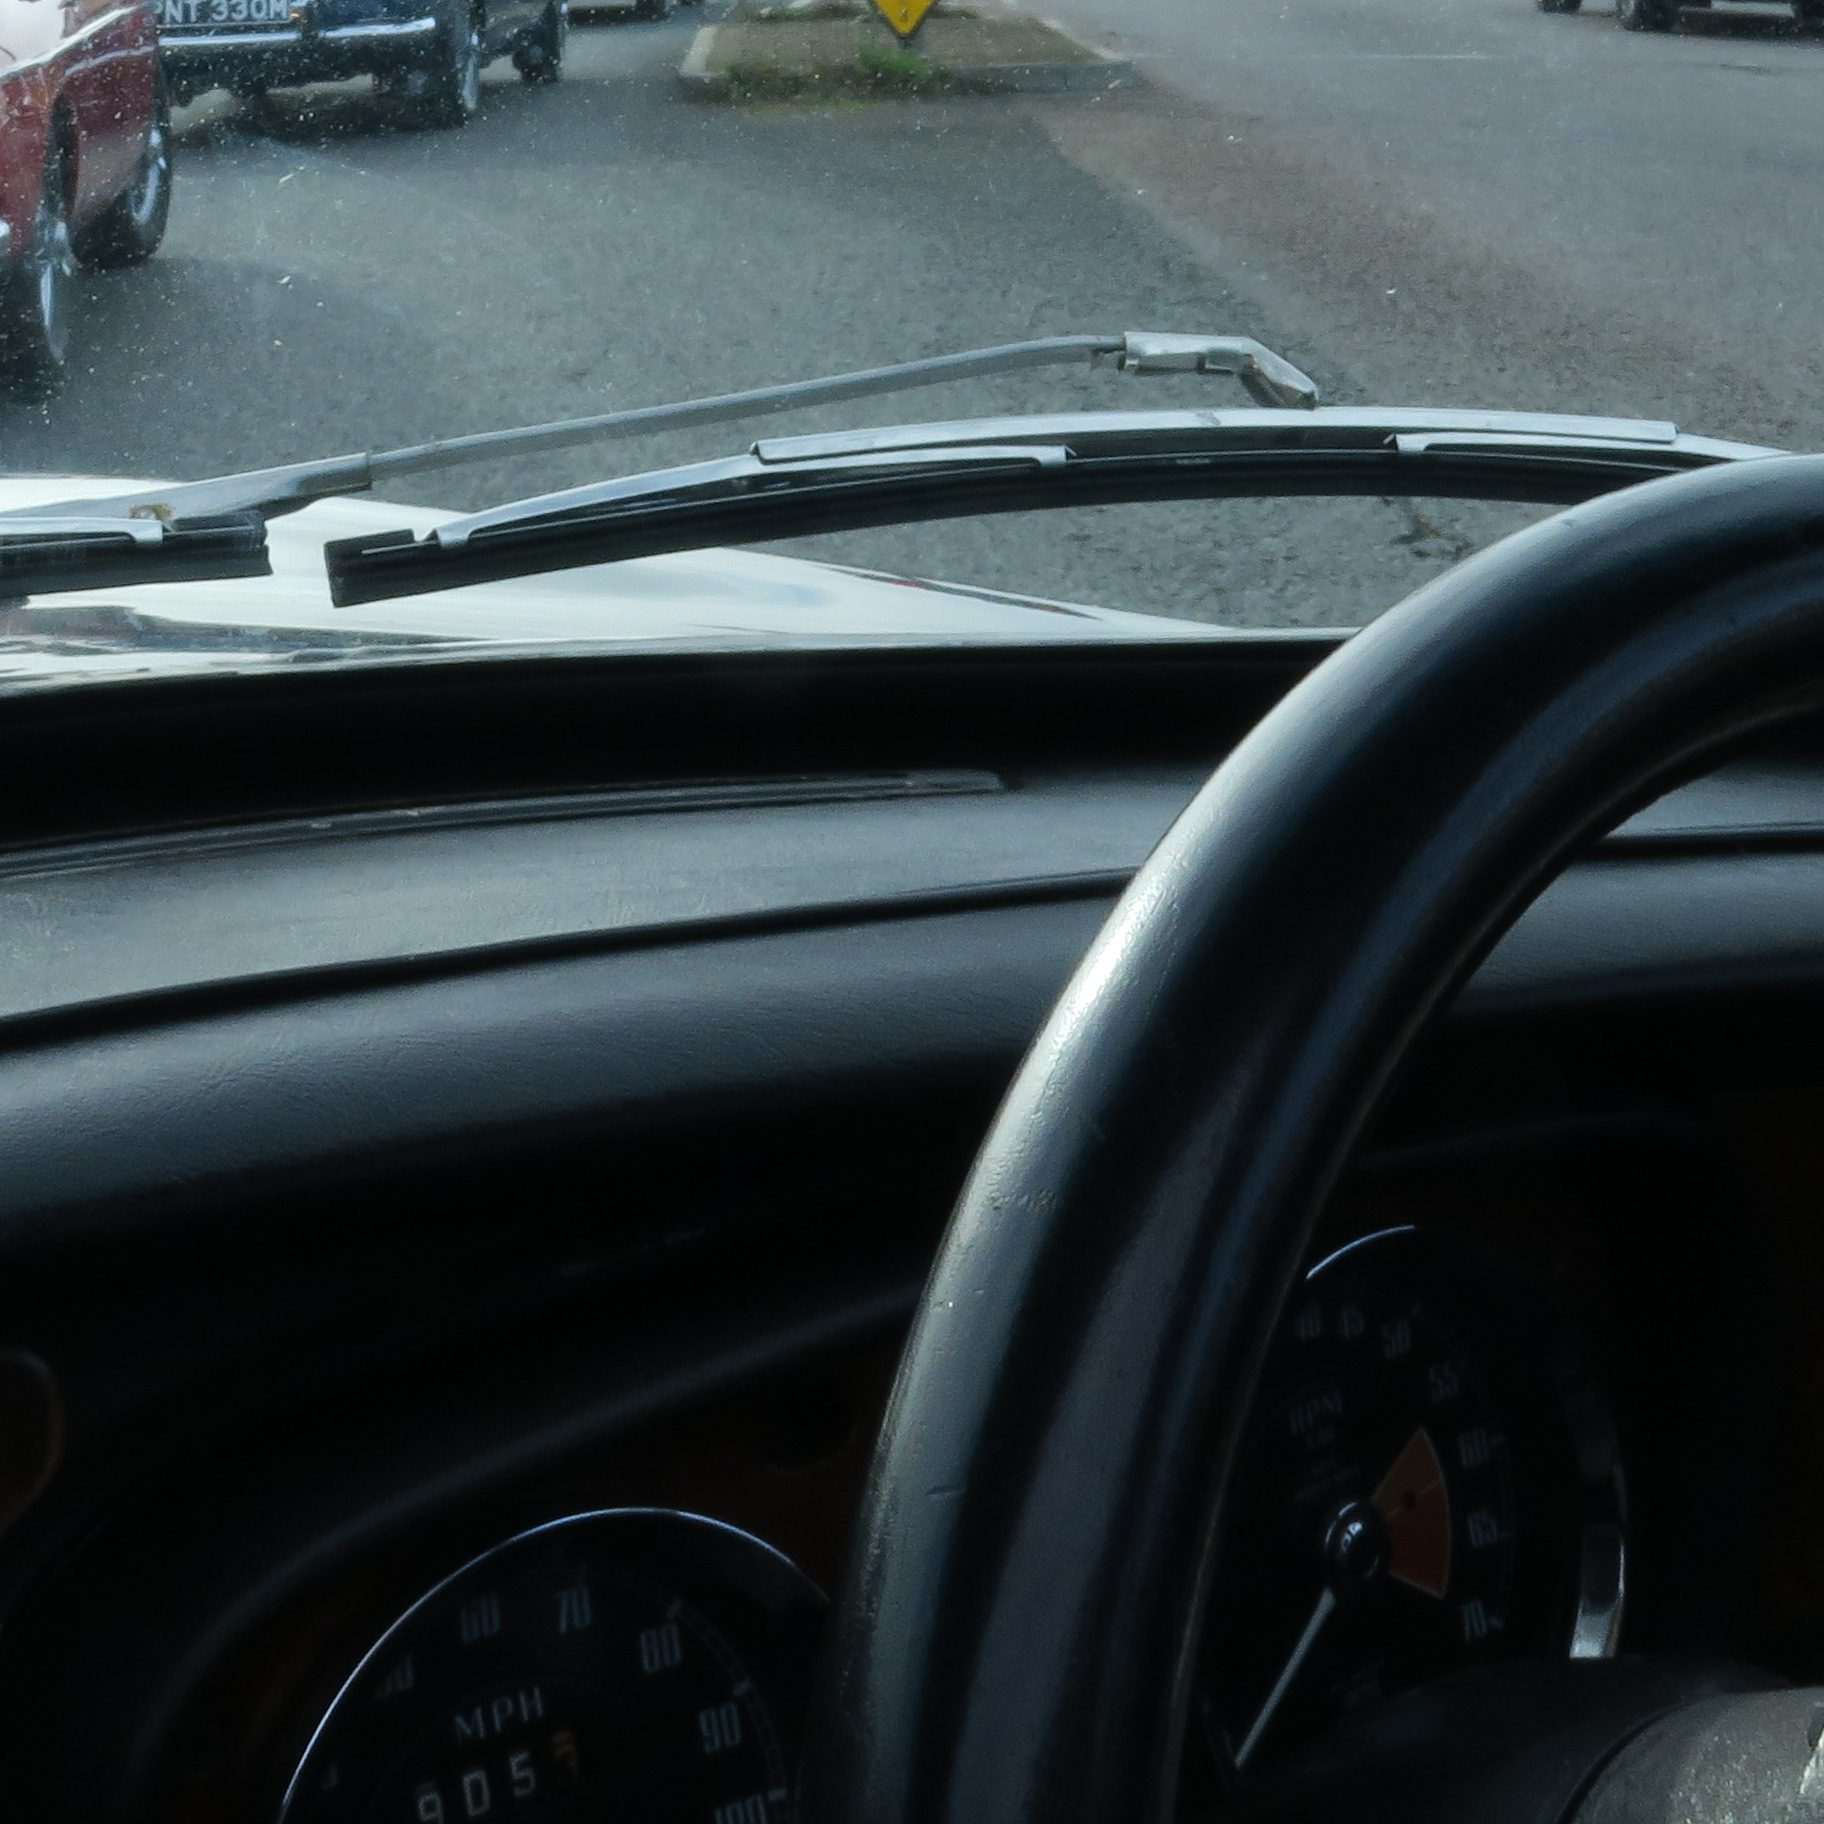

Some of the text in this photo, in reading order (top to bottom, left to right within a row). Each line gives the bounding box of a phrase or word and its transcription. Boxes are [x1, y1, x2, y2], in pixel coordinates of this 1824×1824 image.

[556, 1584, 593, 1635] 70
[638, 1621, 684, 1676] 80
[452, 1684, 545, 1746] MPH
[697, 1700, 743, 1755] 90
